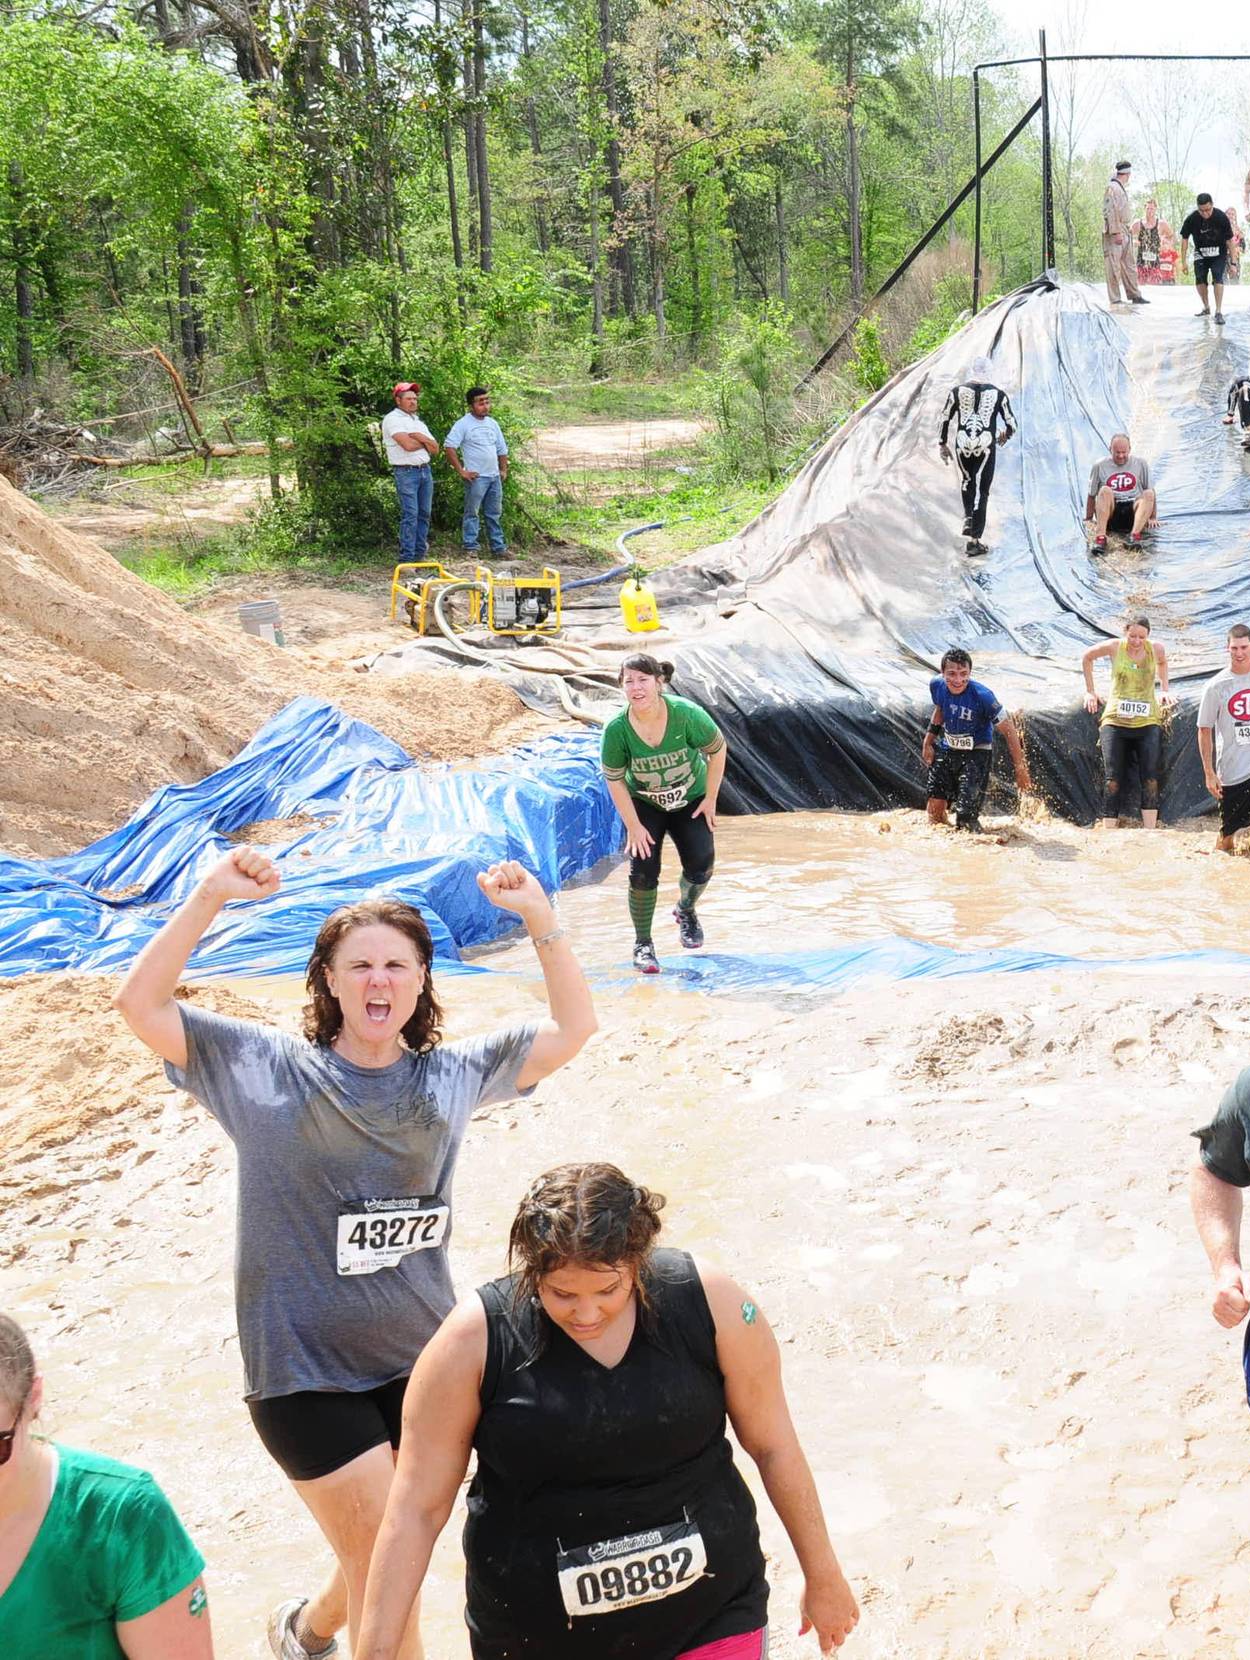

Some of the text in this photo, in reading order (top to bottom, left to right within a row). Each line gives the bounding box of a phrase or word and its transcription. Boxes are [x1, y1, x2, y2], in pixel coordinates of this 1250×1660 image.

[1110, 474, 1133, 490] STP
[1119, 702, 1148, 714] 40152
[347, 1213, 440, 1251] 43272
[576, 1546, 697, 1607] 09882
